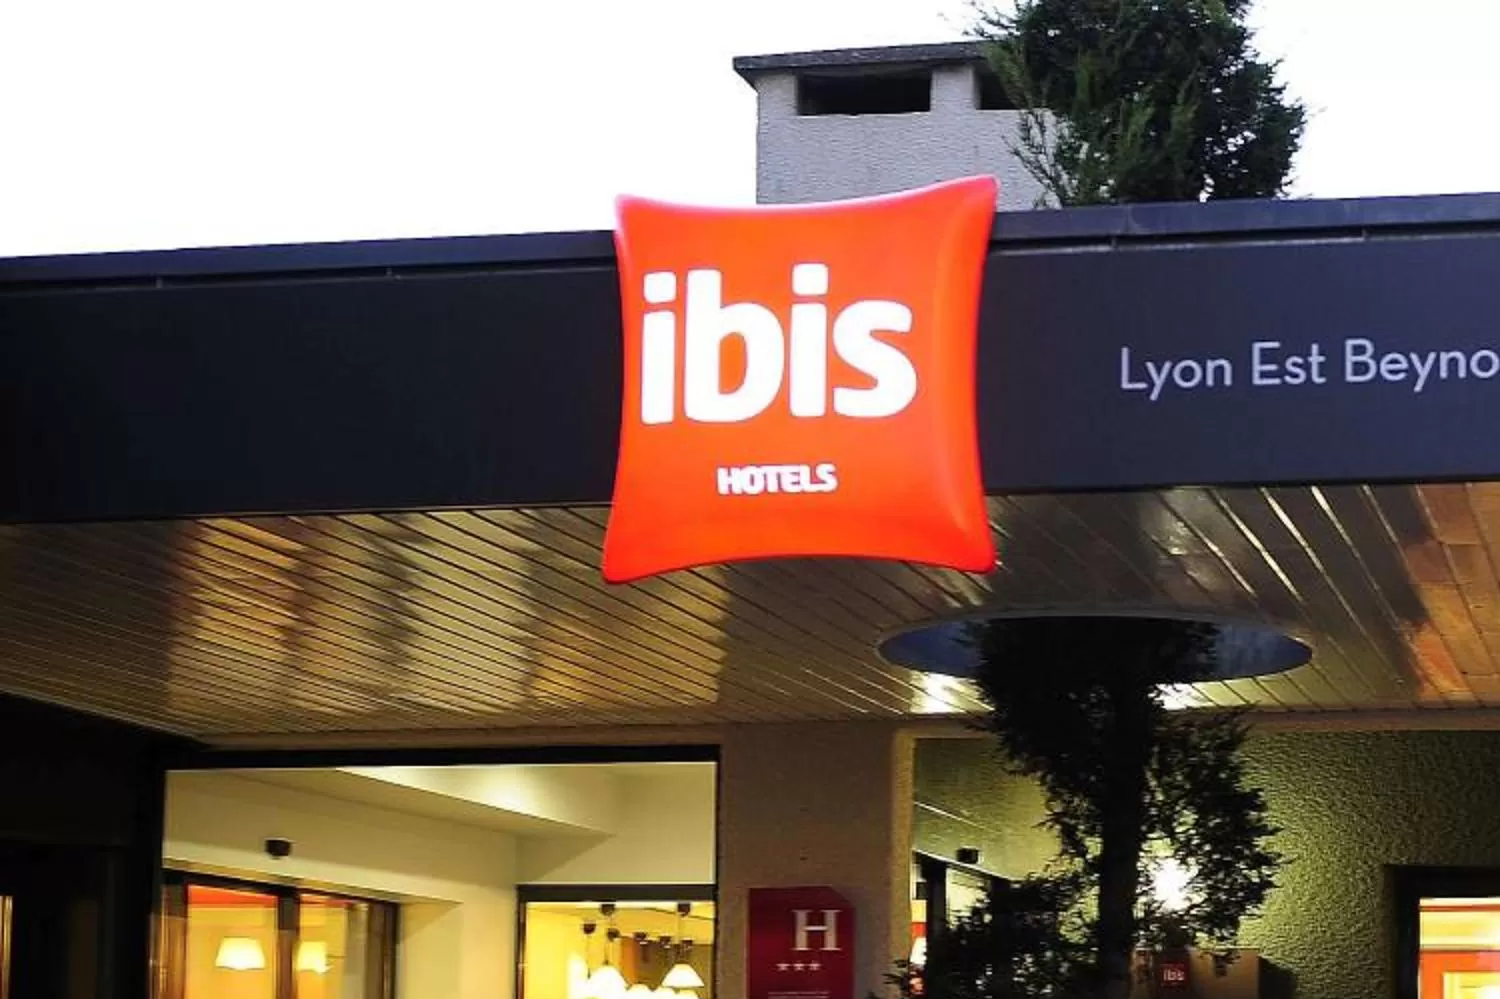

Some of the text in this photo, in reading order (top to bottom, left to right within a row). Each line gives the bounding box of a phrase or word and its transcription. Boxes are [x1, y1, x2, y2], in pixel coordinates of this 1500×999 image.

[641, 263, 918, 426] ibis
[1120, 346, 1233, 401] Lyon
[1251, 341, 1327, 386] Est
[716, 463, 838, 496] HOTELS
[790, 908, 843, 952] H
